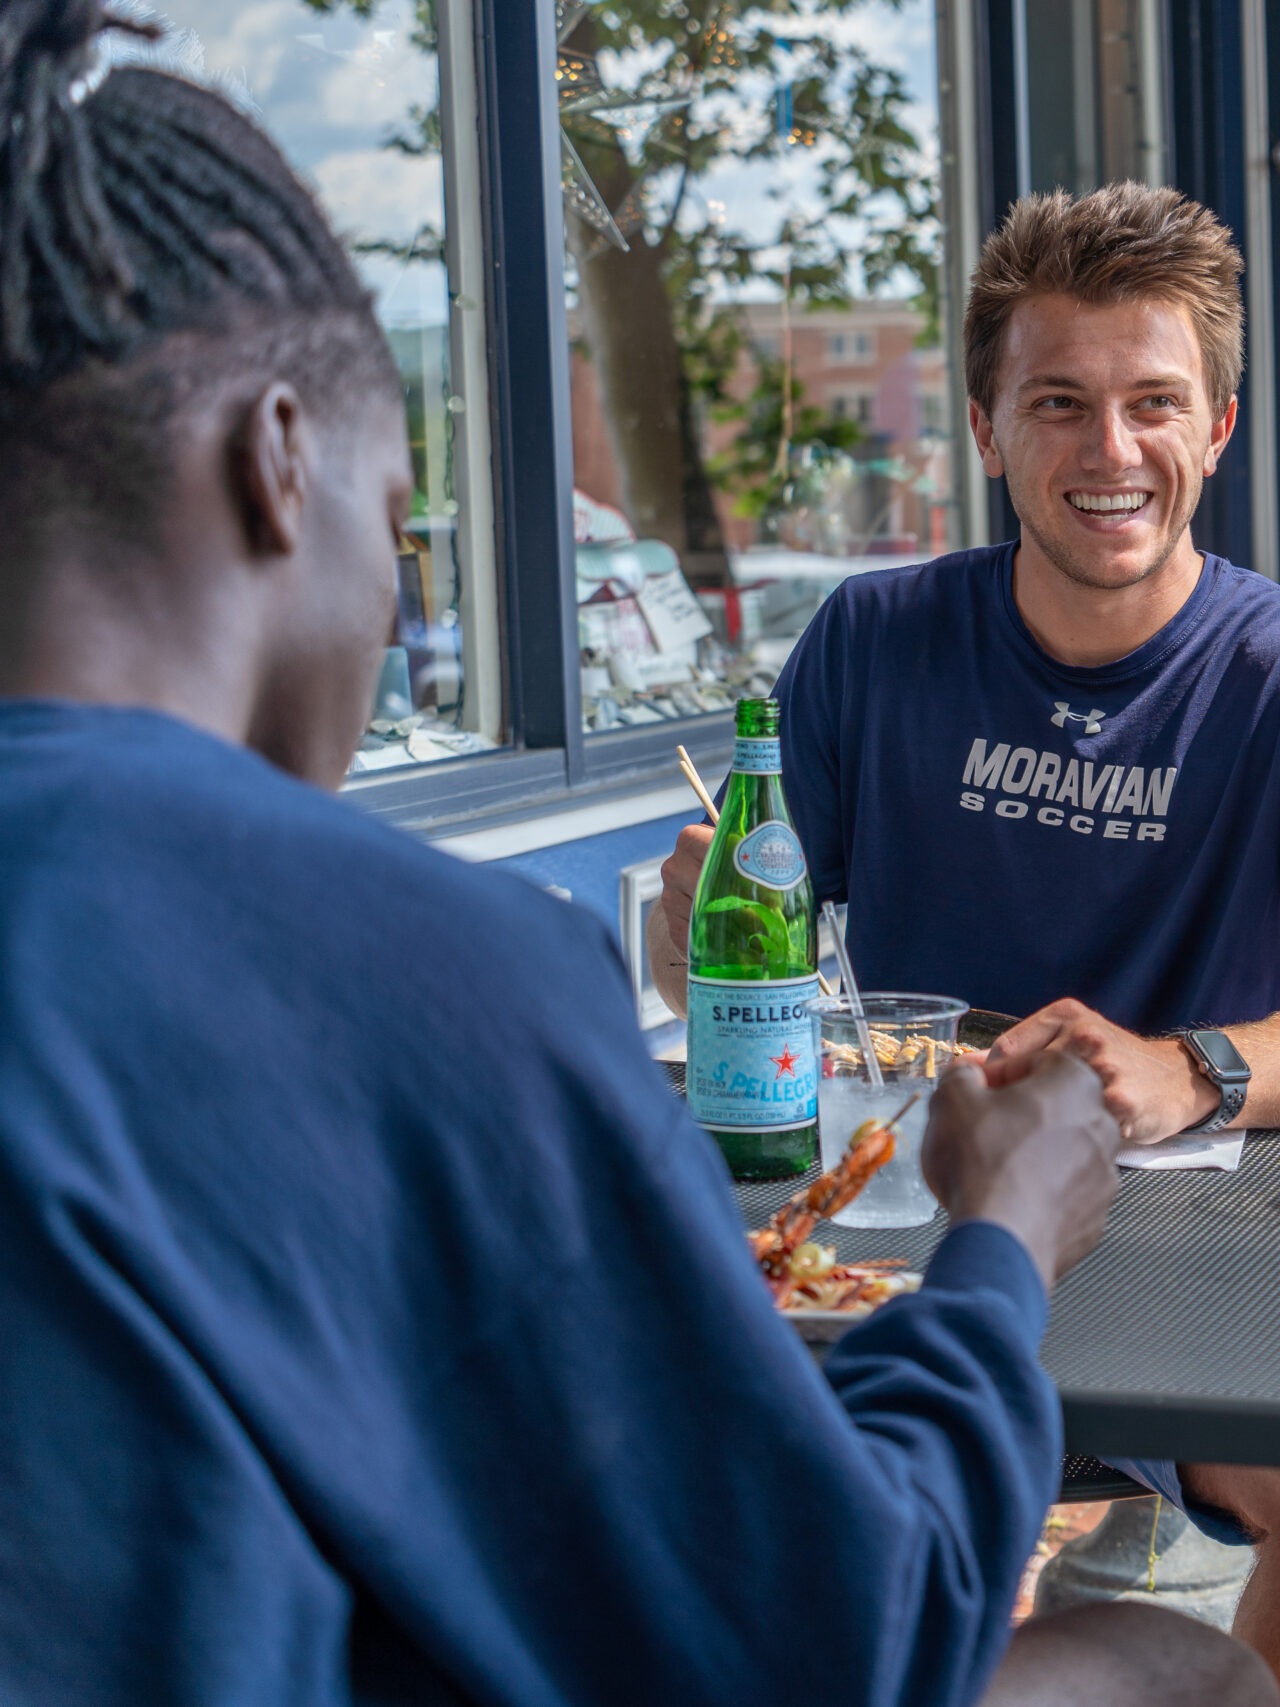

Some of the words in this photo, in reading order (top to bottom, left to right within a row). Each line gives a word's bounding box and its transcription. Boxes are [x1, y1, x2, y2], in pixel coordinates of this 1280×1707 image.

[962, 738, 1177, 816] MORAVIAN
[959, 792, 1167, 841] SOCCER
[717, 1026, 758, 1034] SPARKLING
[760, 1026, 793, 1034] NATURAL
